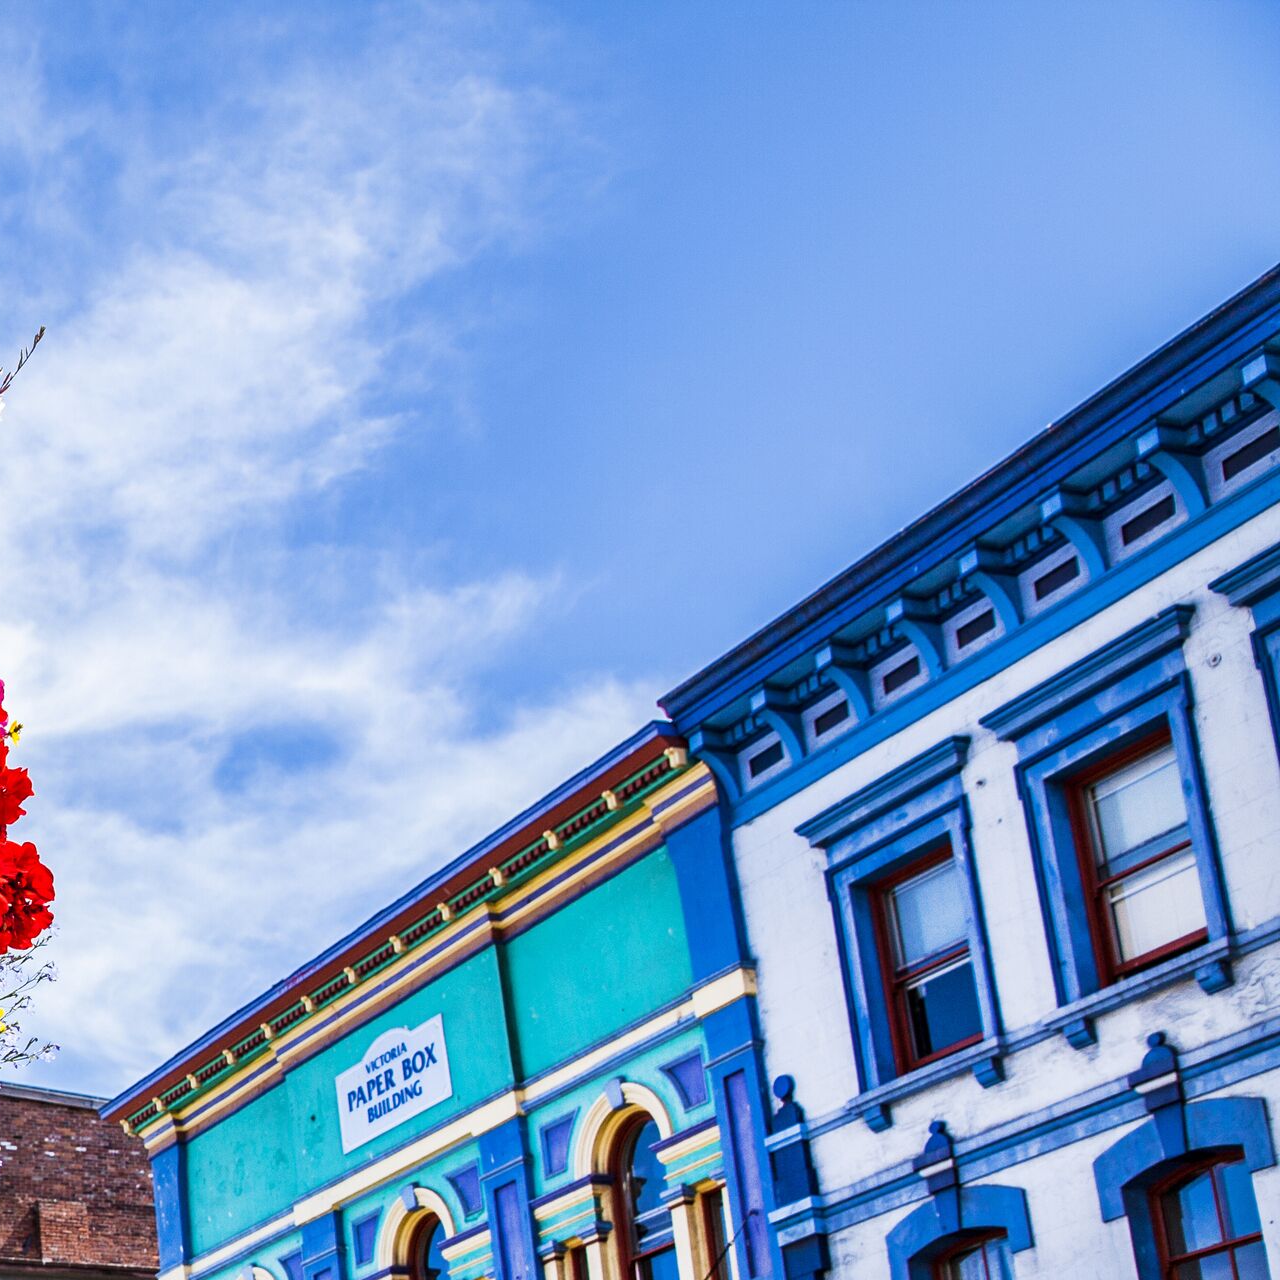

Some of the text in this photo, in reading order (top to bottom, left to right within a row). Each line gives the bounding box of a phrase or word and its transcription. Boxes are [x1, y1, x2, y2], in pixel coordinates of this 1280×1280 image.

[348, 1043, 437, 1111] PAPER BOX
[366, 1043, 407, 1073] VICTORIA
[368, 1080, 422, 1122] BUILDING
